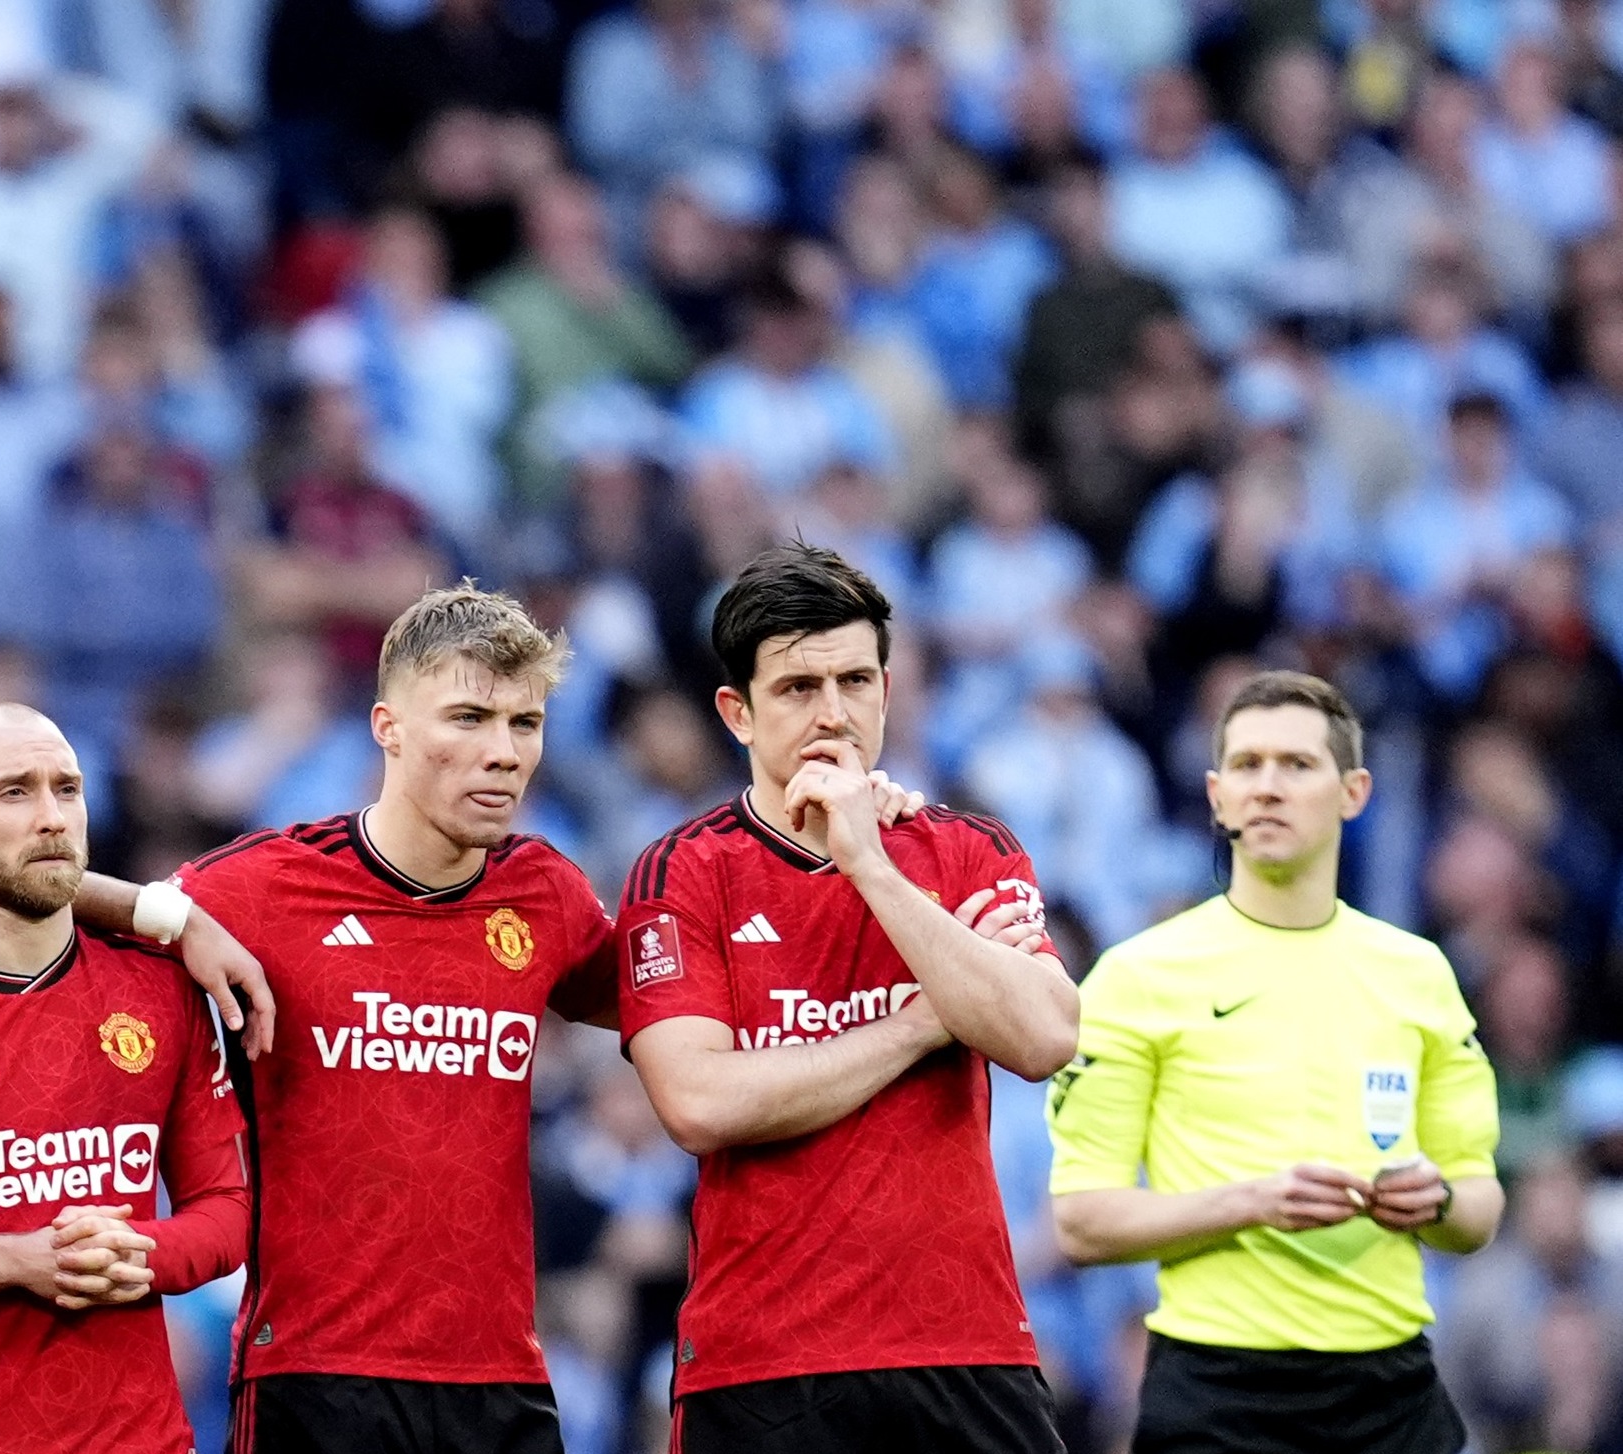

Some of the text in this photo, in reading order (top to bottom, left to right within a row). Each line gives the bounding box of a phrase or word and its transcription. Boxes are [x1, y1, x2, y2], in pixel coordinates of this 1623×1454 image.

[636, 963, 677, 983] FA CUP
[353, 992, 488, 1040] Team
[769, 986, 888, 1032] Team
[311, 1026, 485, 1076] Viewer
[1367, 1072, 1407, 1092] FIFA
